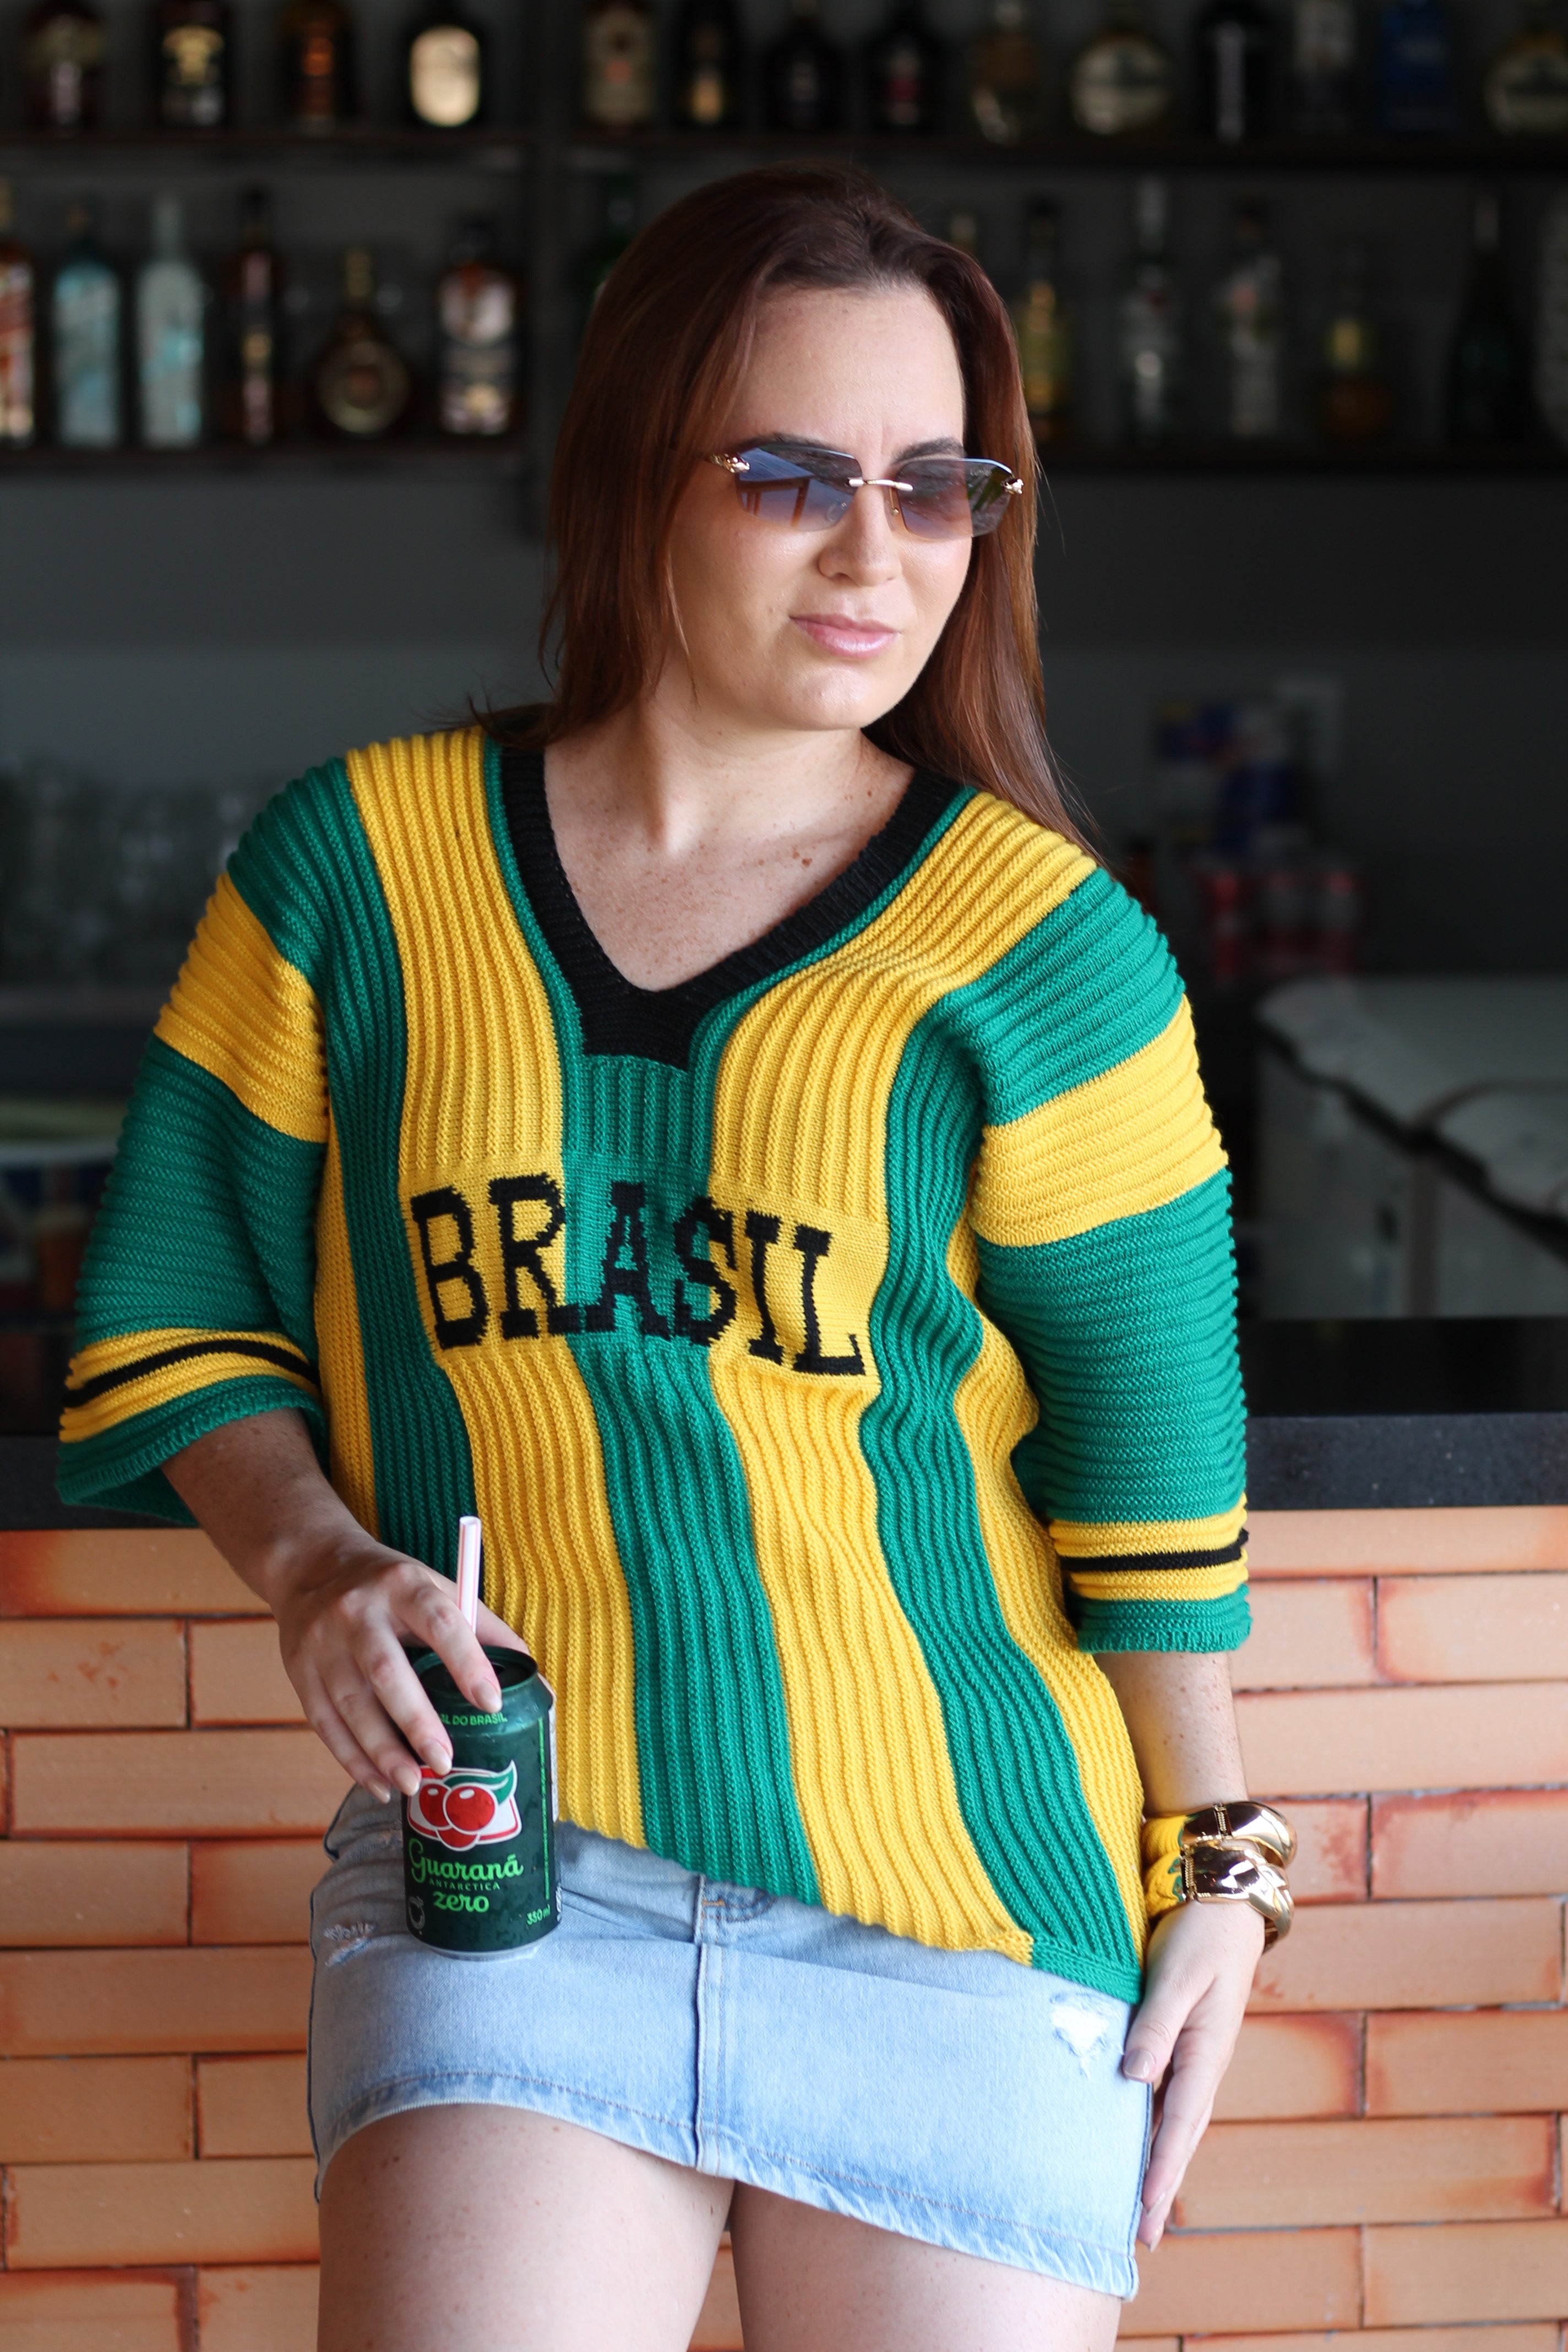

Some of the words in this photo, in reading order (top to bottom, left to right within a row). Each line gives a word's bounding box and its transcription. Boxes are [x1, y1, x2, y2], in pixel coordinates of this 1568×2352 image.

[411, 1172, 865, 1375] BRASIL
[452, 1714, 468, 1725] DO
[470, 1711, 508, 1725] BRASIL
[409, 1838, 524, 1883] Guaraná
[429, 1878, 500, 1891] ANTARCTICA
[433, 1891, 489, 1913] zero
